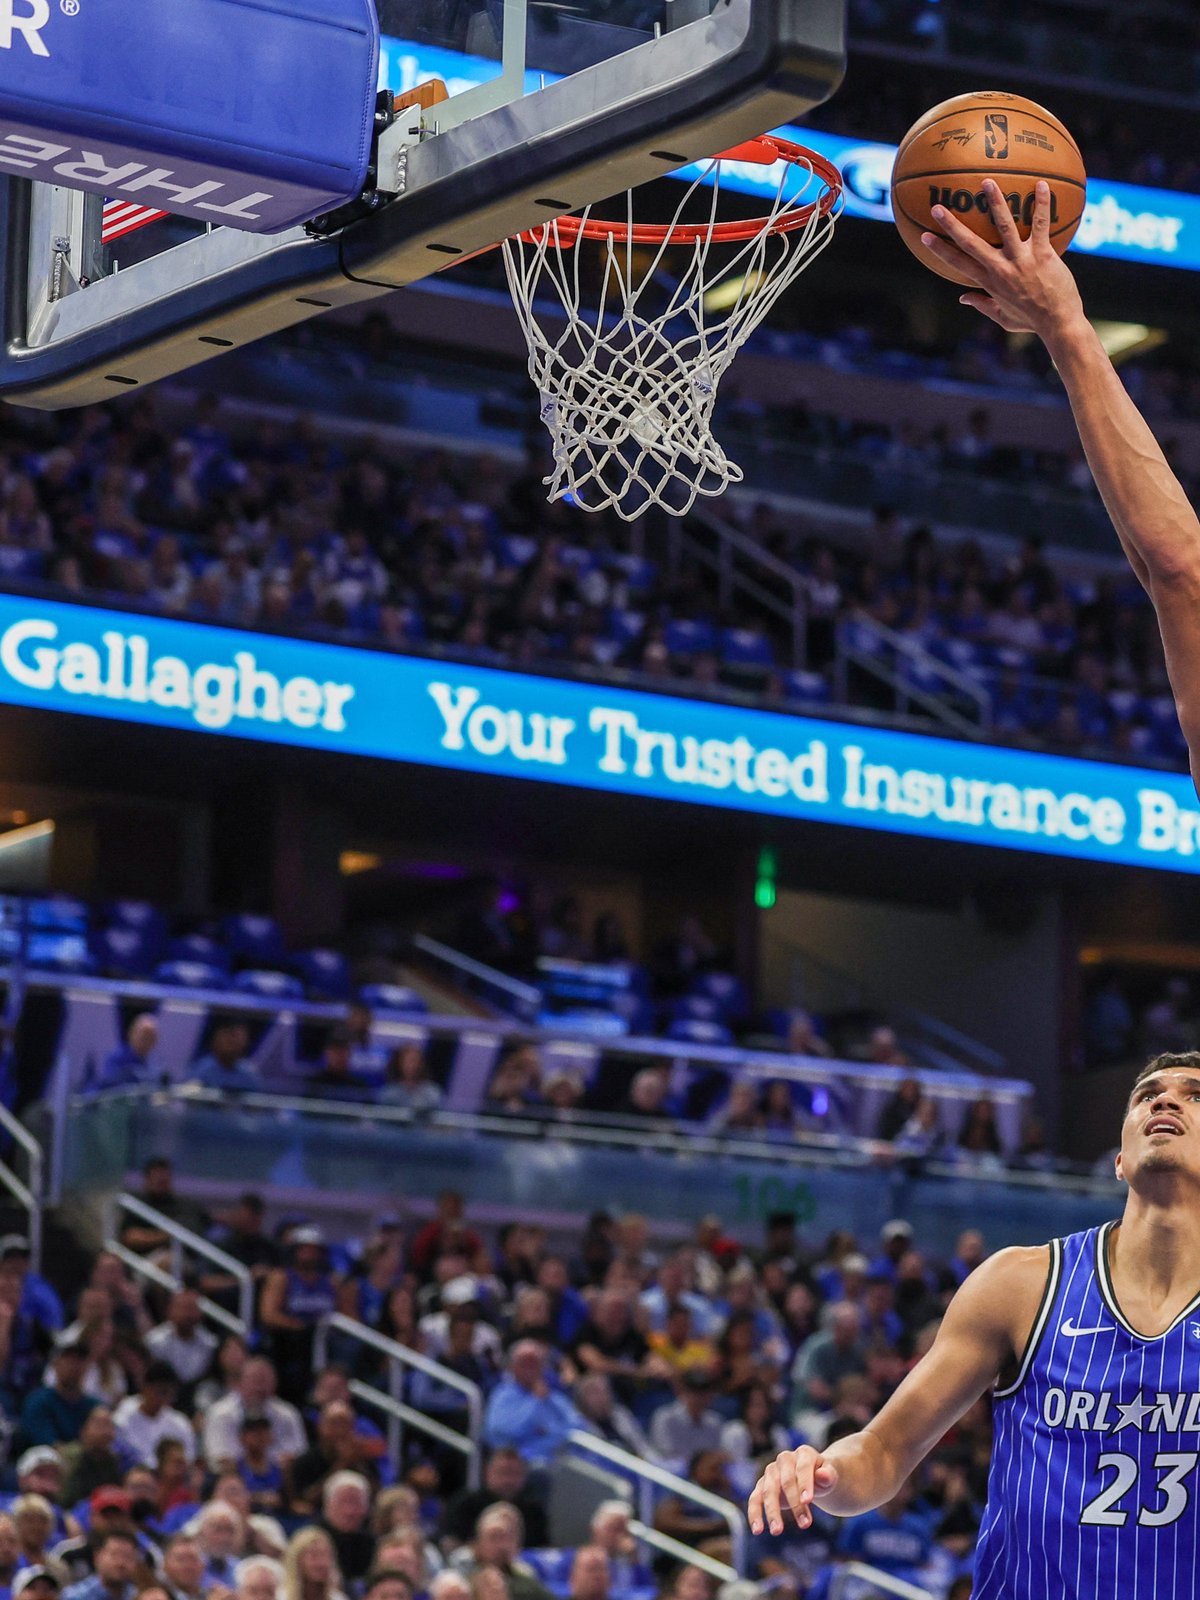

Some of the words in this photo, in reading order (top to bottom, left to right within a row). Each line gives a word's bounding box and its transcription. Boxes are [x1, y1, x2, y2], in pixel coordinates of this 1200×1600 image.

[0, 619, 354, 733] Gallagher
[427, 681, 576, 766] Your
[589, 706, 829, 804] Trusted
[842, 745, 1125, 846] Insurance
[1079, 1451, 1200, 1527] 23
